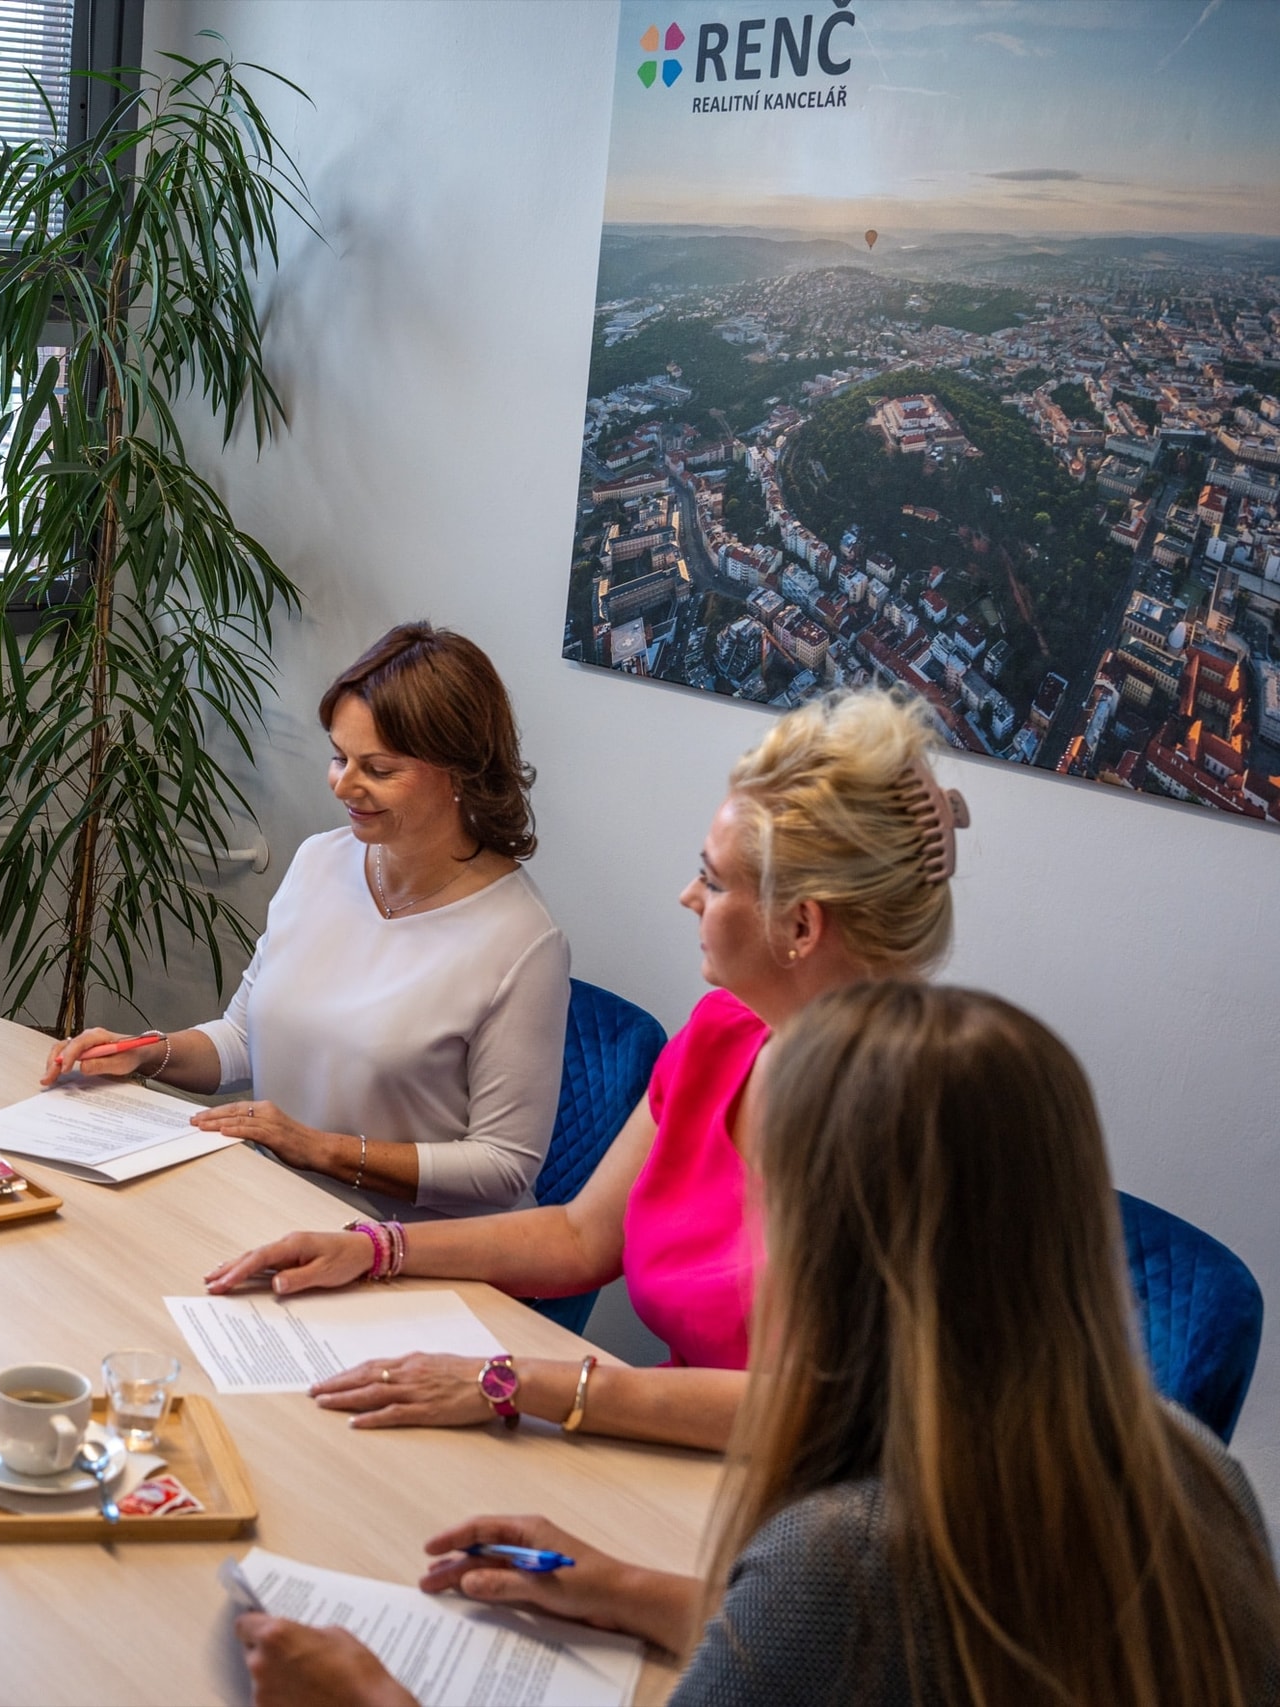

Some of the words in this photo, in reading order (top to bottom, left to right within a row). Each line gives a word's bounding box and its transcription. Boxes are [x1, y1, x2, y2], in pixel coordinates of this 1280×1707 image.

[695, 0, 856, 83] RENČ
[692, 90, 761, 113] REALITNÍ
[764, 85, 848, 110] KANCELÁŘ
